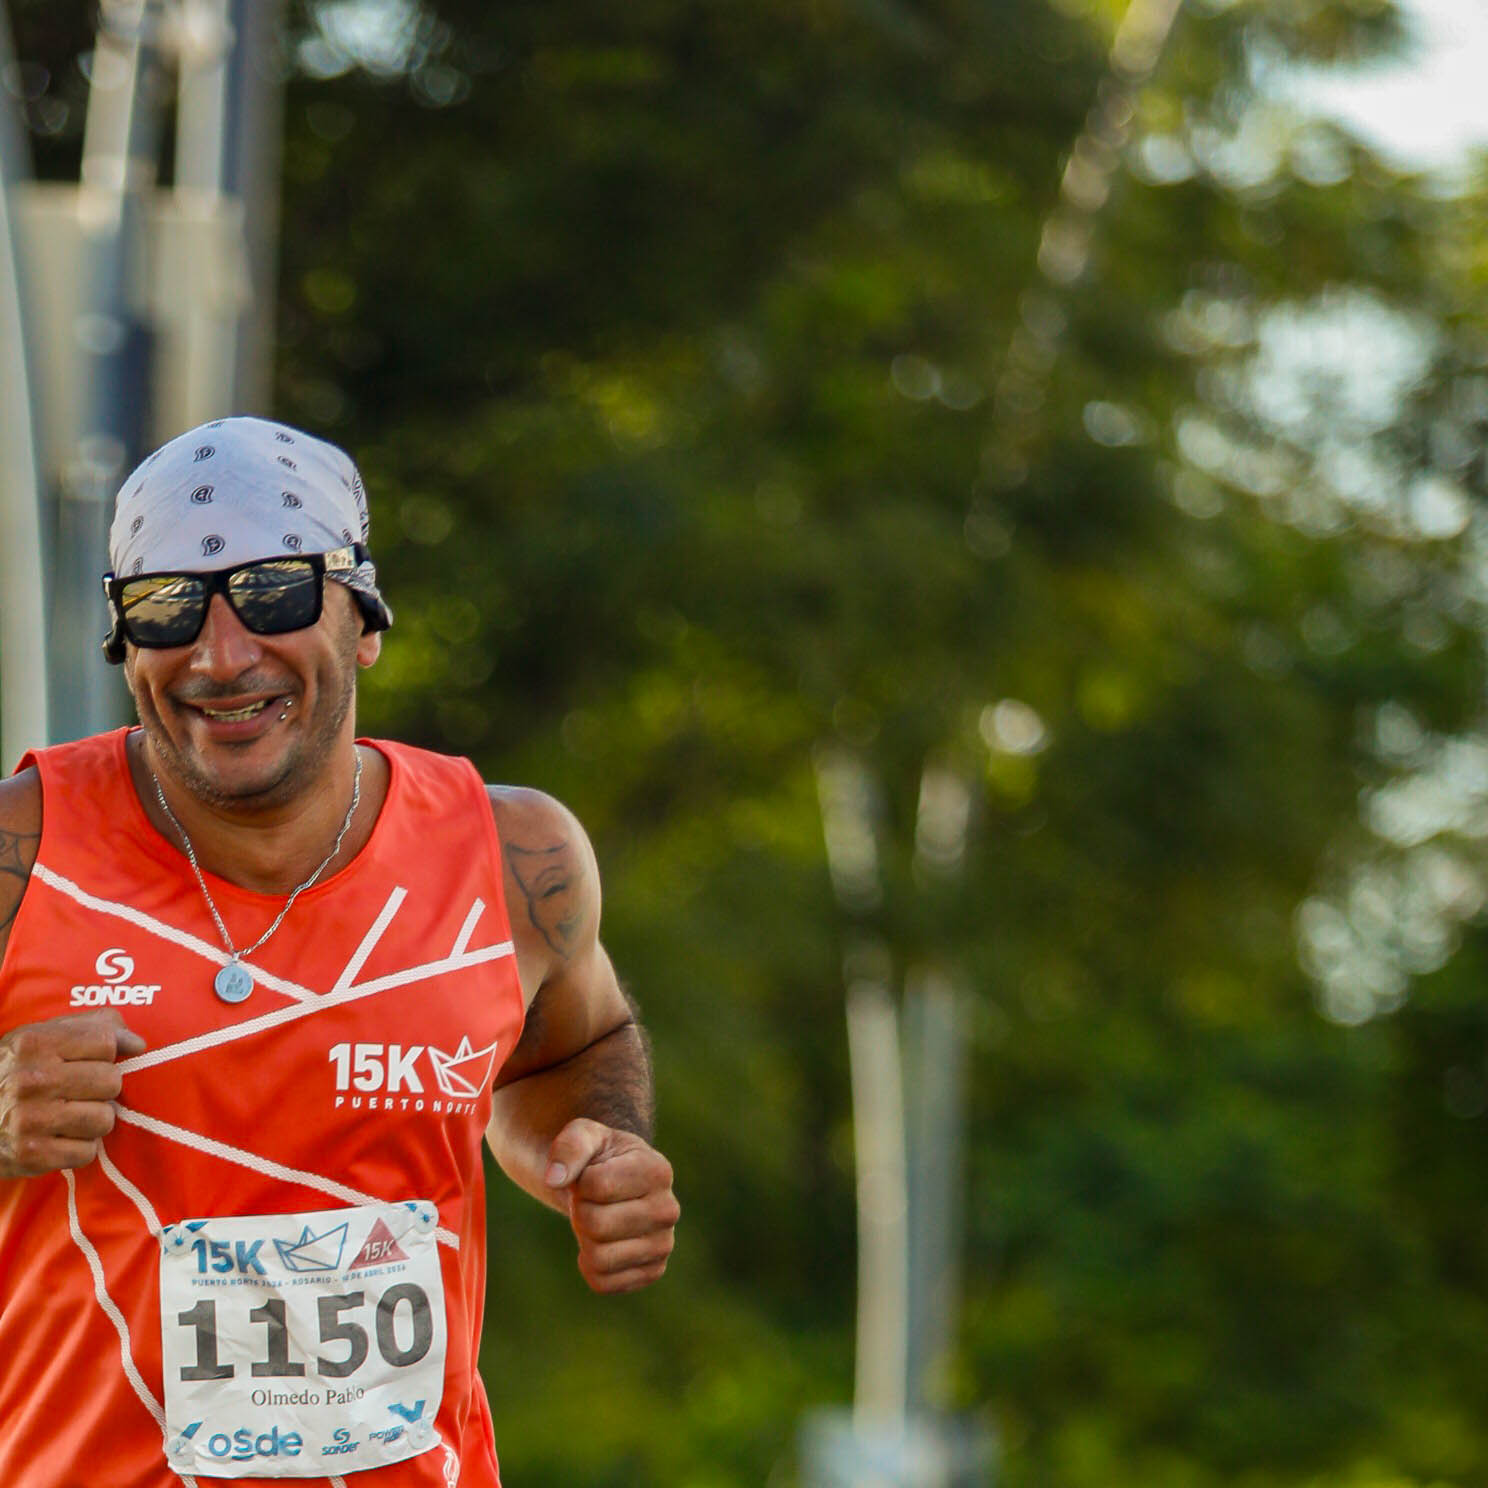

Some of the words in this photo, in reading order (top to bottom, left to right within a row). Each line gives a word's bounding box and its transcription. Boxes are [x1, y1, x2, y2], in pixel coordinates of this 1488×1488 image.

[328, 1042, 425, 1093] 15K
[334, 1096, 425, 1112] PUERTO
[432, 1100, 477, 1116] NORTE
[191, 1238, 268, 1275] 15K
[363, 1238, 395, 1262] 15K
[191, 1279, 227, 1287] PUERTO
[292, 1275, 332, 1285] ROSARIO
[178, 1282, 434, 1382] 1150
[251, 1388, 320, 1406] Olmedo
[208, 1425, 304, 1458] osde
